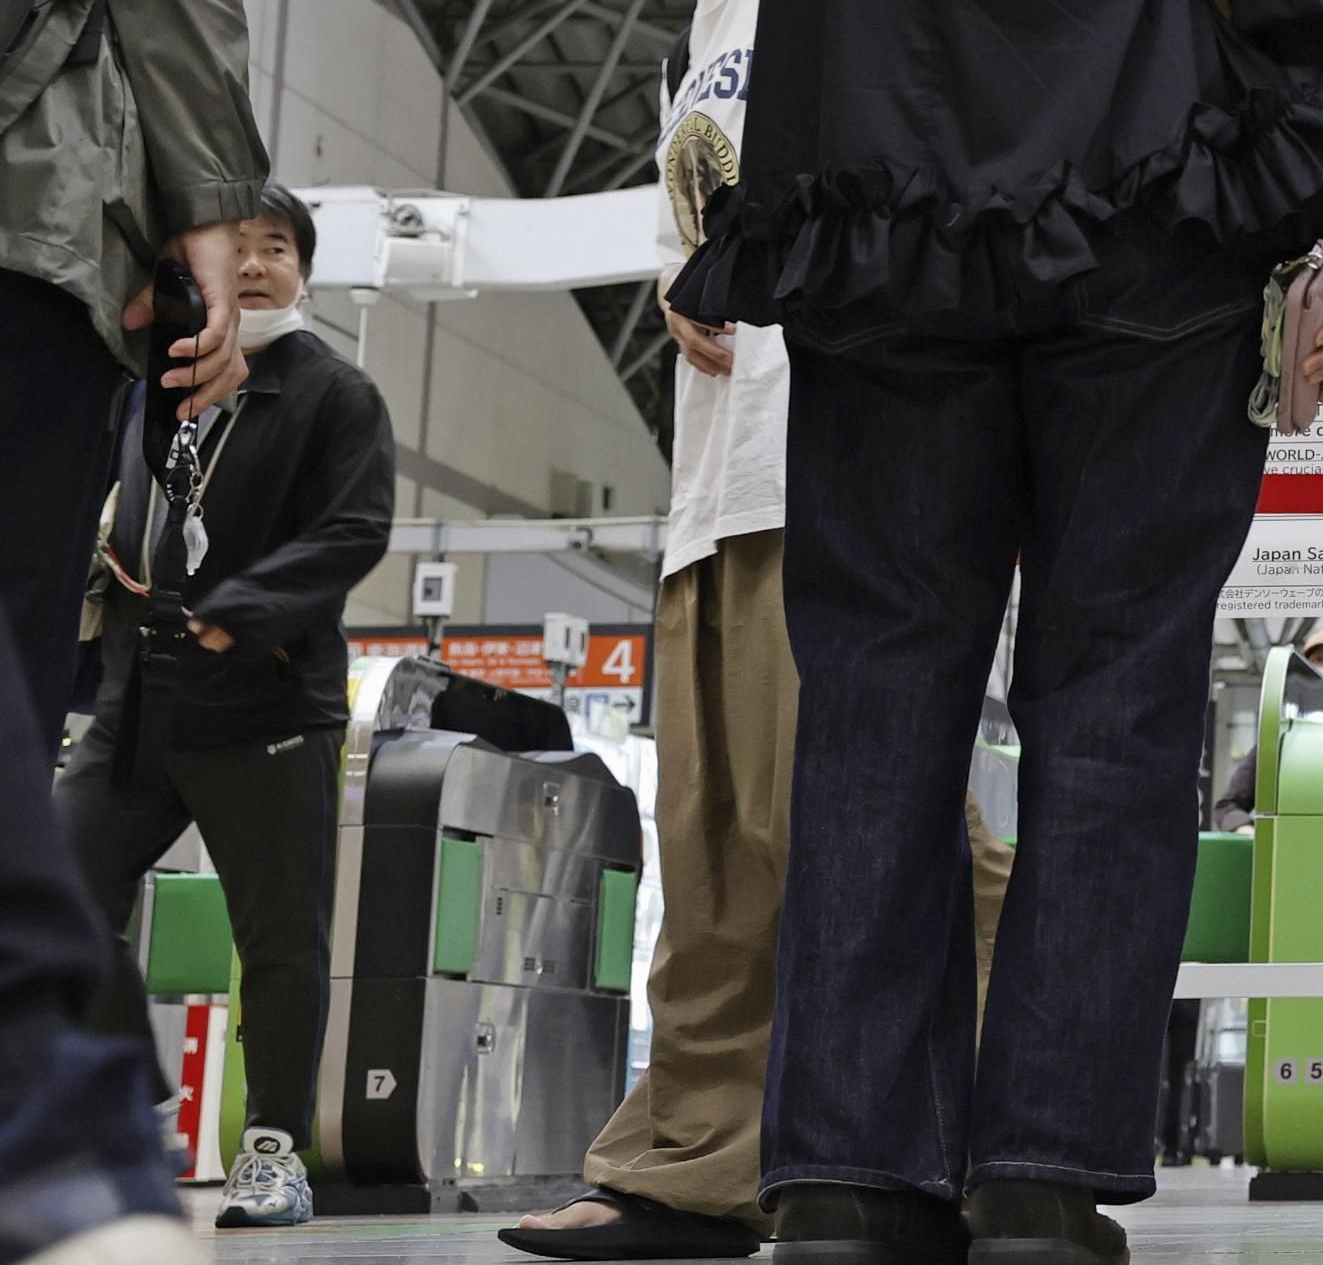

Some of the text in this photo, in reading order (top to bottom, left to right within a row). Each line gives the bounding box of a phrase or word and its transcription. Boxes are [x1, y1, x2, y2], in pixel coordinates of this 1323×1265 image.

[1252, 546, 1302, 563] Japan
[1256, 563, 1300, 576] (Japan
[1217, 600, 1272, 612] registered
[602, 639, 636, 684] 4
[1280, 1062, 1323, 1080] 6 5
[373, 1075, 386, 1092] 7
